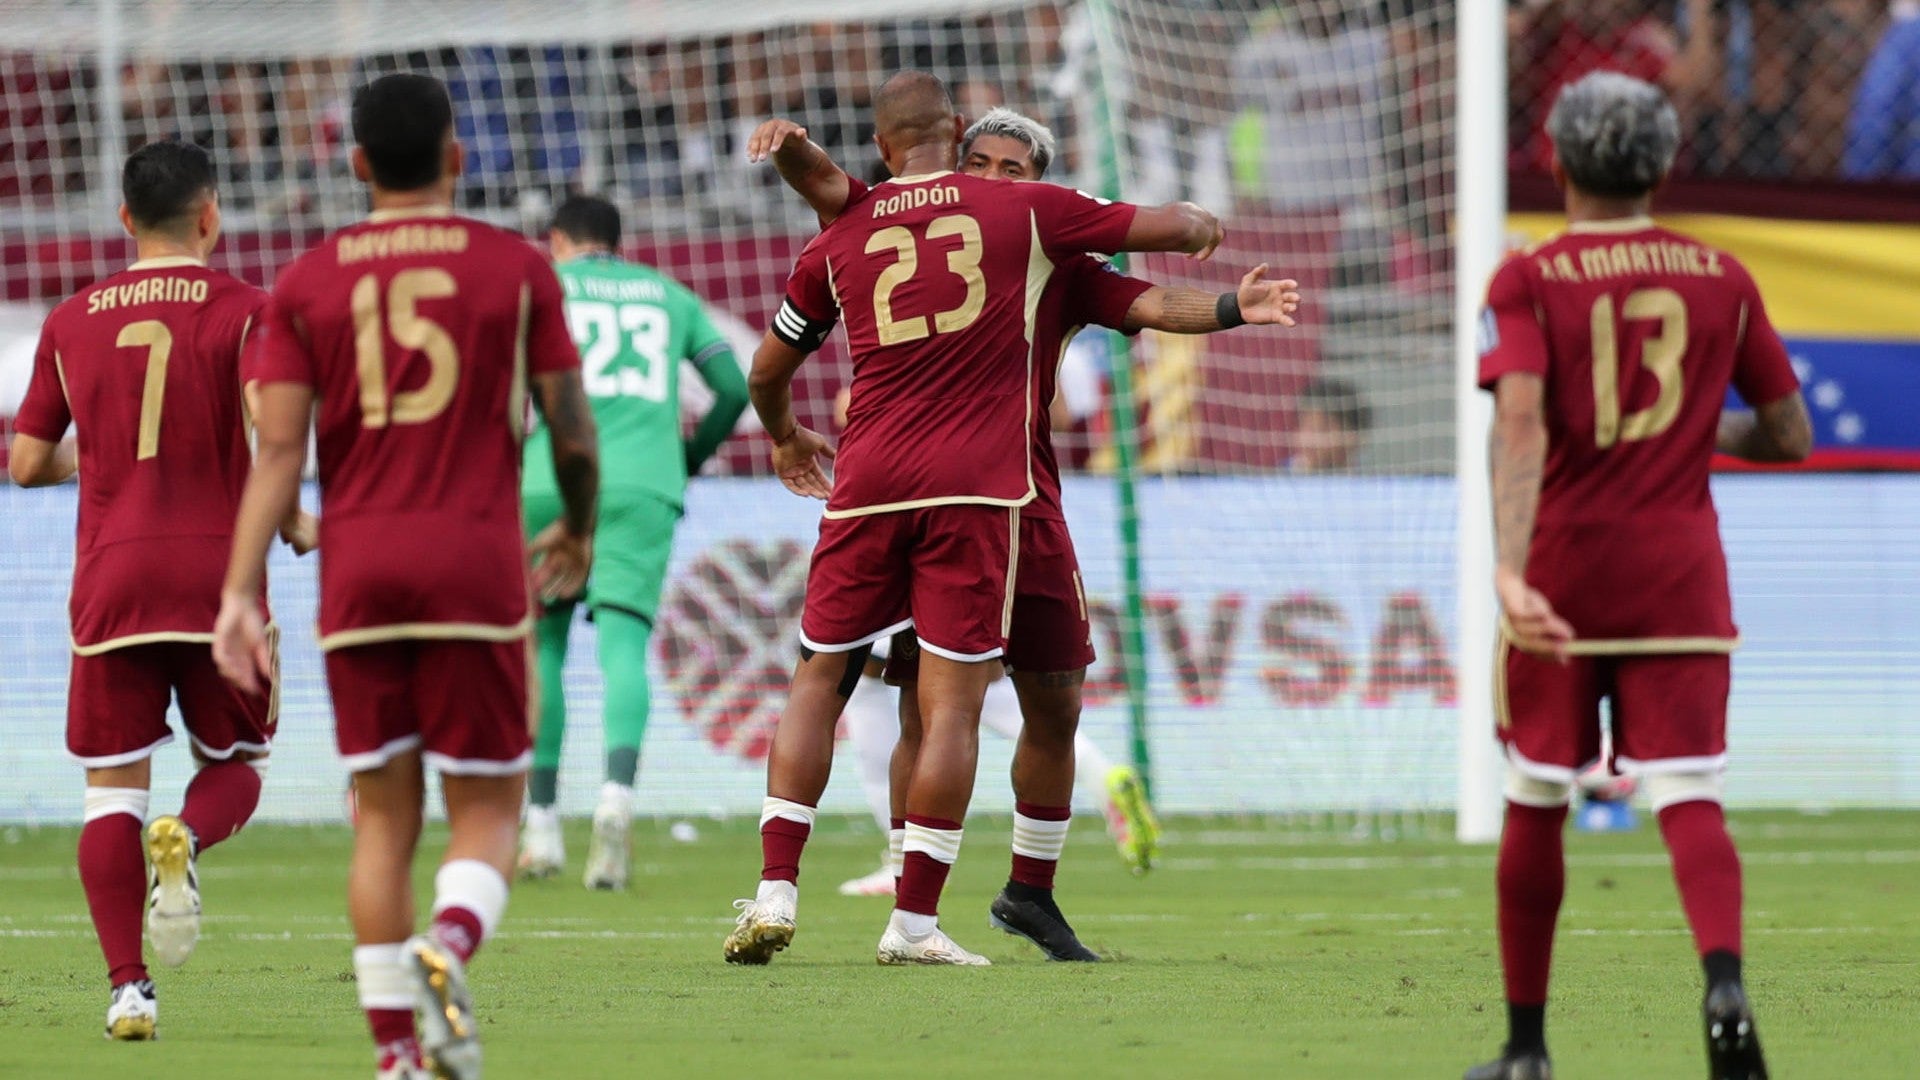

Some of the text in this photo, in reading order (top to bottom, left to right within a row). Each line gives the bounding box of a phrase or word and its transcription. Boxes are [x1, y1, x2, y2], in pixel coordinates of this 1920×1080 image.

[872, 183, 960, 219] RONDÓN
[87, 276, 208, 314] SAVARINO
[864, 214, 987, 346] 23
[116, 319, 172, 461] 7
[351, 268, 460, 430] 15
[566, 300, 671, 402] 23
[1590, 287, 1689, 448] 13
